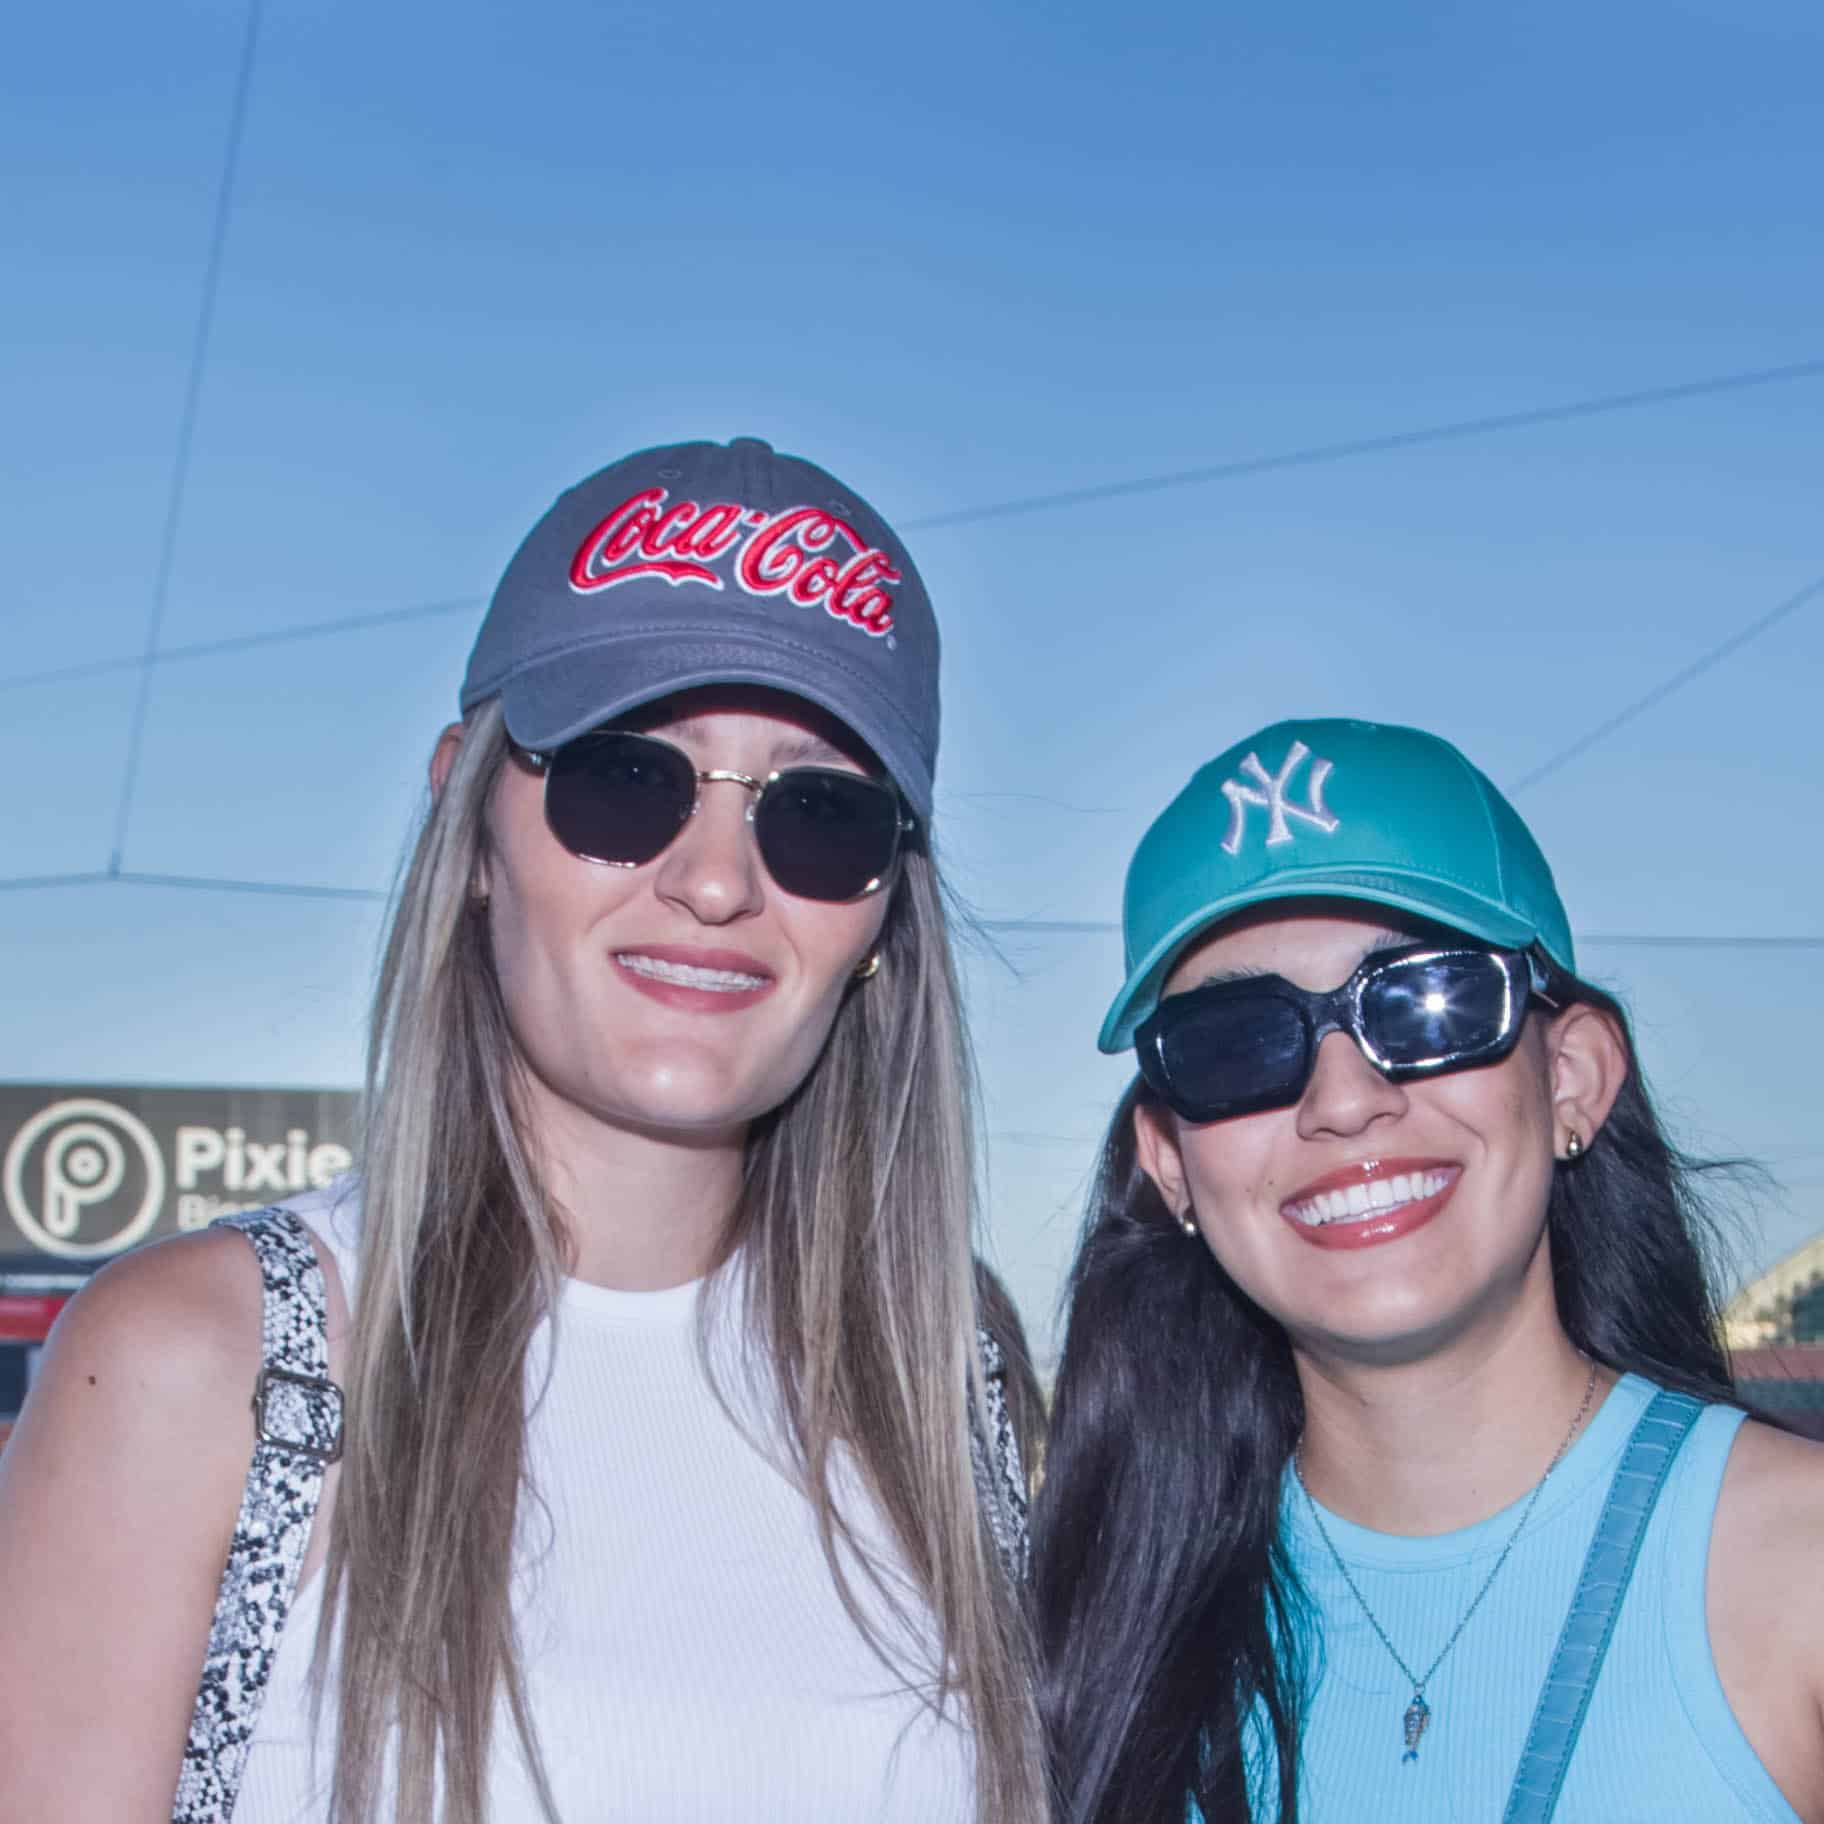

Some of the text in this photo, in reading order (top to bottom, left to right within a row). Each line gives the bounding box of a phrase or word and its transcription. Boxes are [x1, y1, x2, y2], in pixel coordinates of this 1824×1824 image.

[569, 486, 902, 638] Coca-Cola
[1220, 740, 1341, 856] NY
[176, 1126, 353, 1191] Pixie
